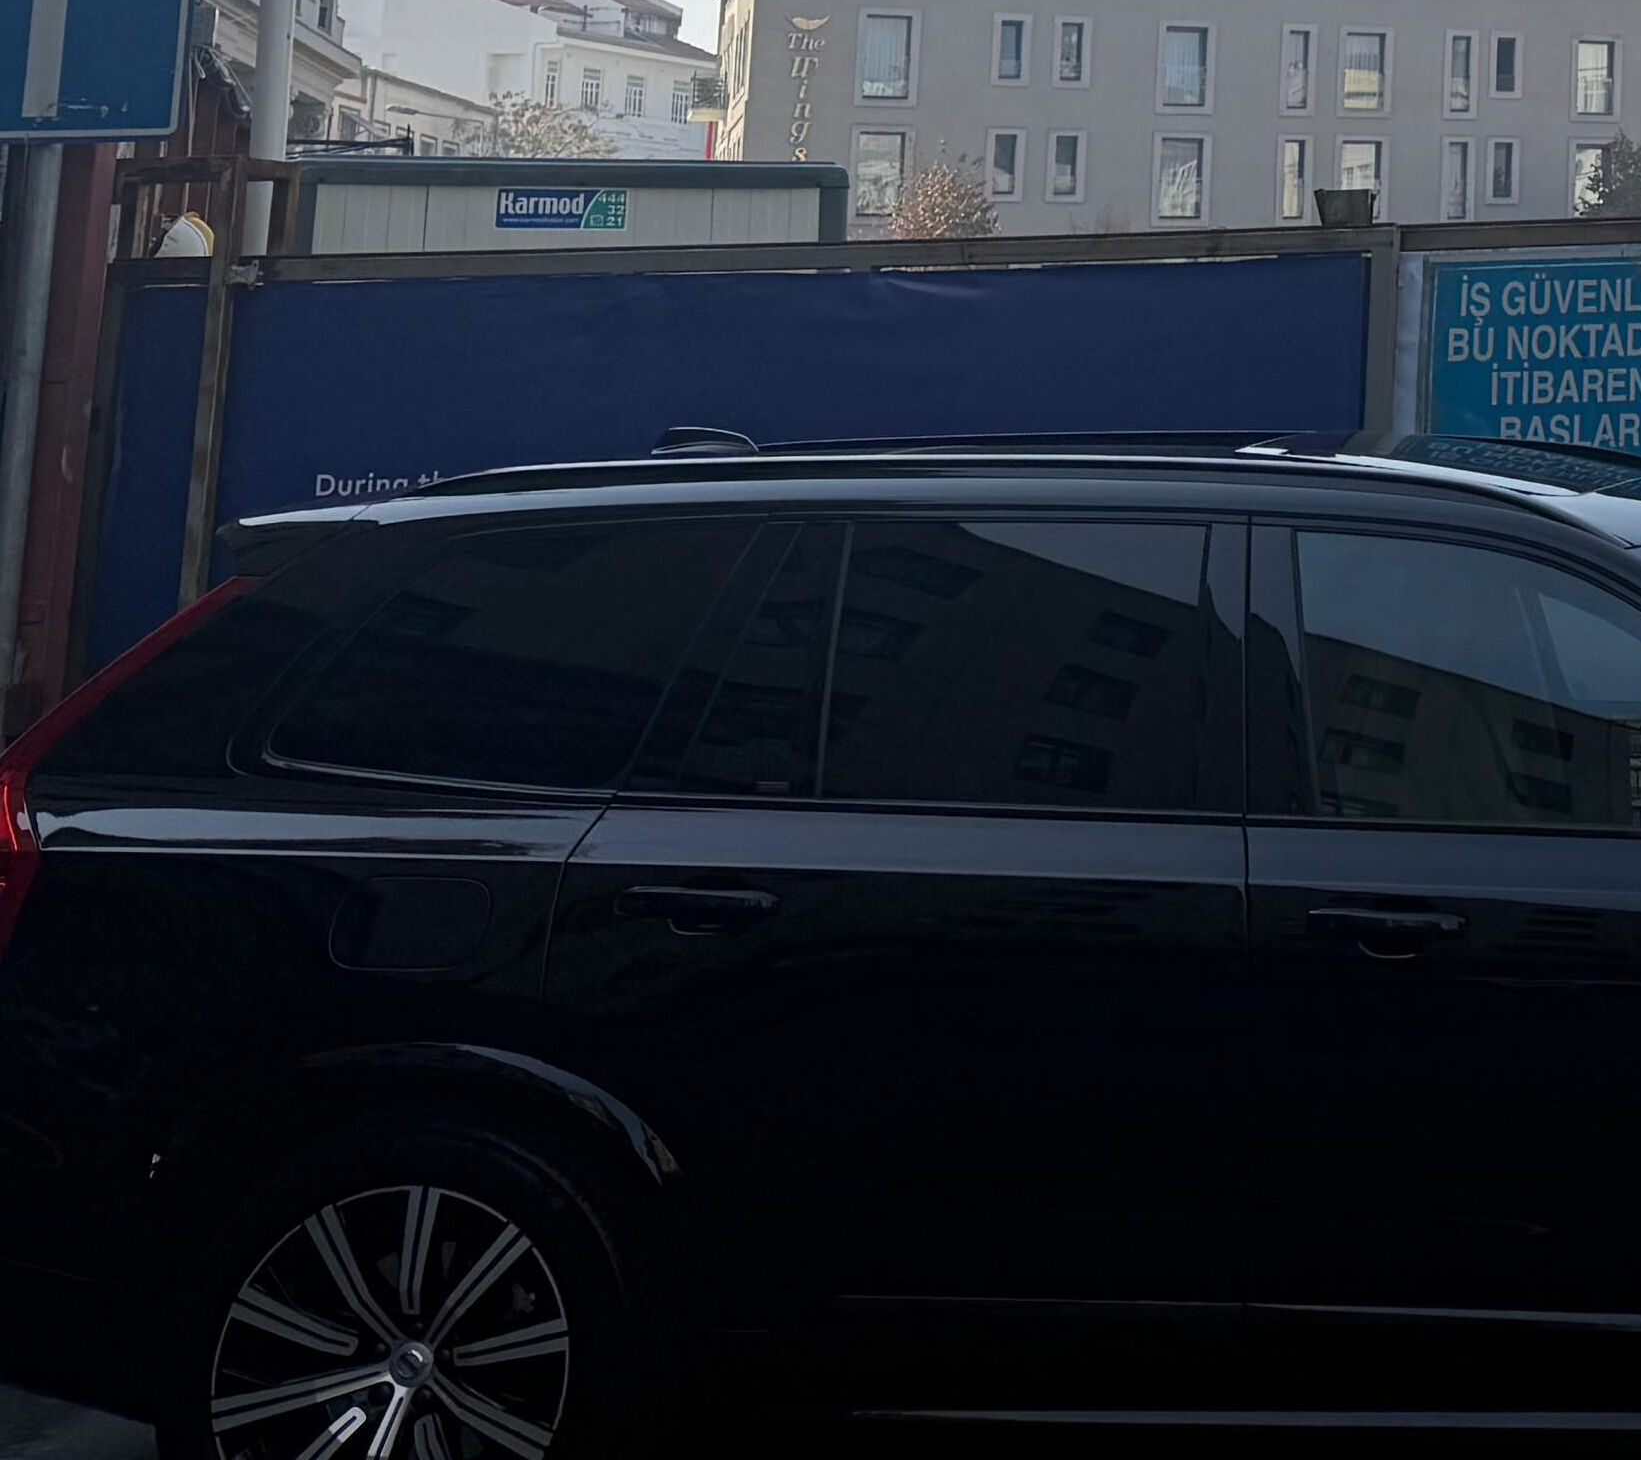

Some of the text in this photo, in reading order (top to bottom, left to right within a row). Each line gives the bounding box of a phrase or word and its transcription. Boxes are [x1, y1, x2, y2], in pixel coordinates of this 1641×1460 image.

[788, 33, 826, 51] The
[500, 192, 585, 215] Karmod
[598, 193, 626, 203] 444
[607, 205, 626, 215] 32
[606, 217, 622, 226] 21
[1460, 275, 1491, 326] İŞ
[1447, 327, 1495, 362] BU
